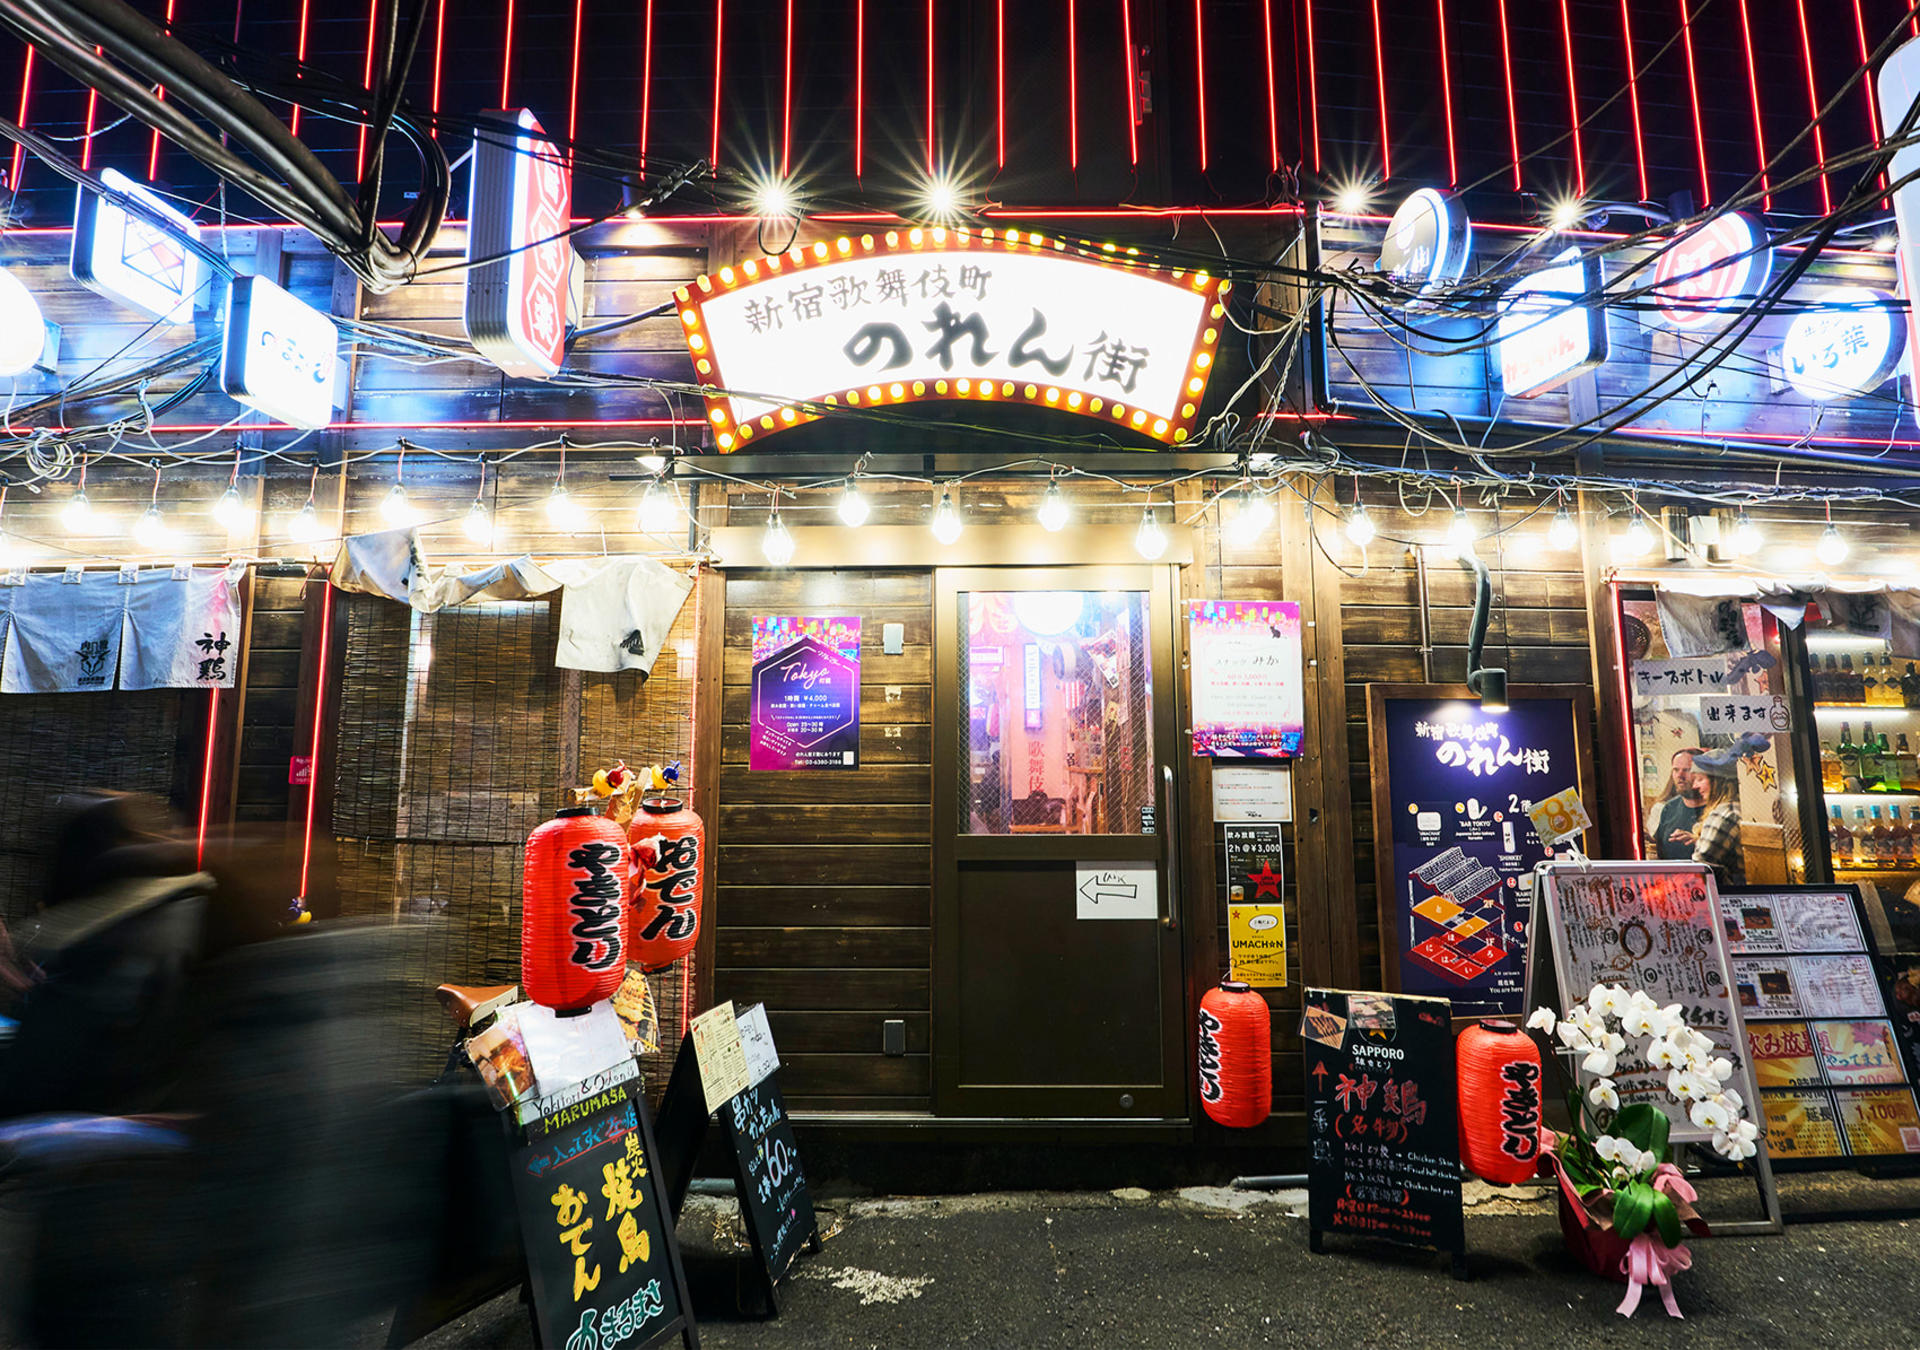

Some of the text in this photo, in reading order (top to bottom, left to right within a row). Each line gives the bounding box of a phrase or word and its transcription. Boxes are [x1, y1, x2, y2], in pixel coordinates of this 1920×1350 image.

[744, 263, 993, 334] 新宿歌舞伎町
[842, 300, 1151, 394] のれん街
[1792, 324, 1869, 375] いろ葉
[195, 632, 231, 681] 神鶏
[780, 661, 830, 690] Tokyo
[1637, 668, 1724, 686] キープボトル
[1707, 703, 1767, 723] 出来ます
[1435, 736, 1550, 777] のれん街
[568, 842, 622, 972] やきとり
[640, 836, 699, 940] おでん
[1352, 1044, 1405, 1061] SAPPORO
[1825, 1052, 1884, 1067] やってます
[533, 1092, 580, 1118] Yakitori
[580, 1078, 592, 1095] &
[544, 1085, 628, 1135] MARUMASA
[732, 1088, 759, 1132] 串カツ
[1335, 1073, 1428, 1126] 神鶏
[1499, 1060, 1541, 1163] やきとり
[552, 1105, 639, 1166] 入ってすぐ左の店
[624, 1131, 648, 1179] 炭火
[1407, 1151, 1436, 1164] Chicken
[765, 1136, 789, 1188] 60
[601, 1157, 651, 1274] 焼鳥
[550, 1183, 602, 1302] おでん
[599, 1278, 665, 1350] まるまさ
